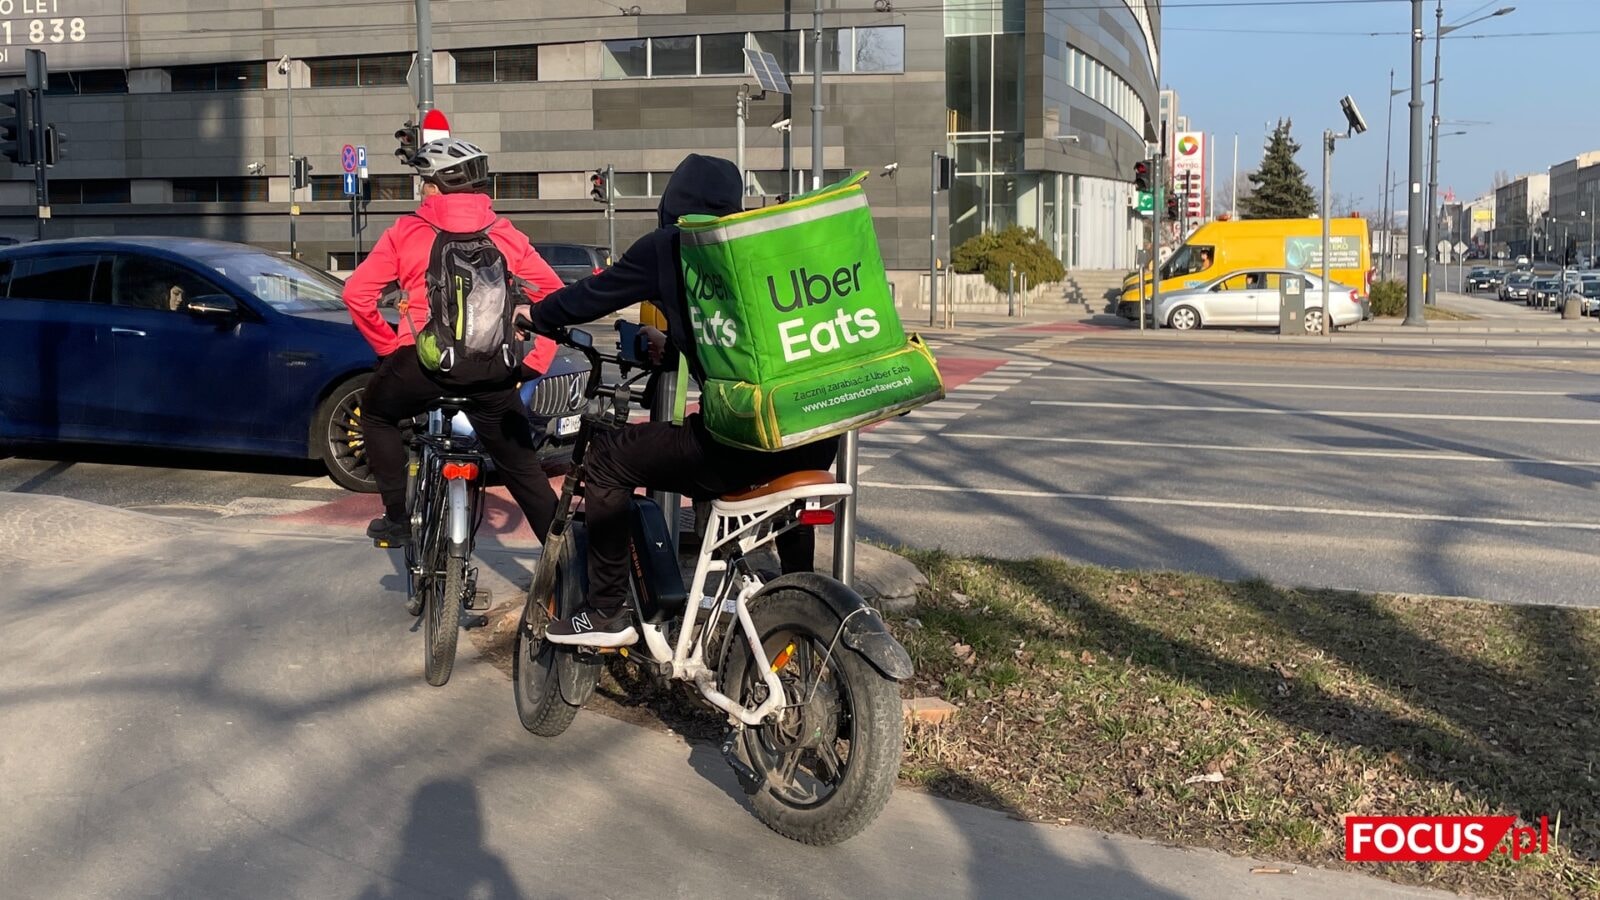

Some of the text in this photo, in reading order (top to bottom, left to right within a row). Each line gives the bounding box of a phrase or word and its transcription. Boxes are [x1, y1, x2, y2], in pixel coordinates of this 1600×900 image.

[29, 18, 86, 43] 838
[358, 148, 365, 165] P
[767, 261, 862, 313] Uber
[690, 306, 737, 348] Eats
[778, 308, 881, 363] Eats
[793, 387, 828, 402] Zacznij
[828, 377, 864, 392] zarabiać
[870, 370, 892, 381] Uber
[891, 364, 911, 376] Eats
[802, 375, 913, 413] www.zostandostawca.pl
[571, 612, 593, 633] N
